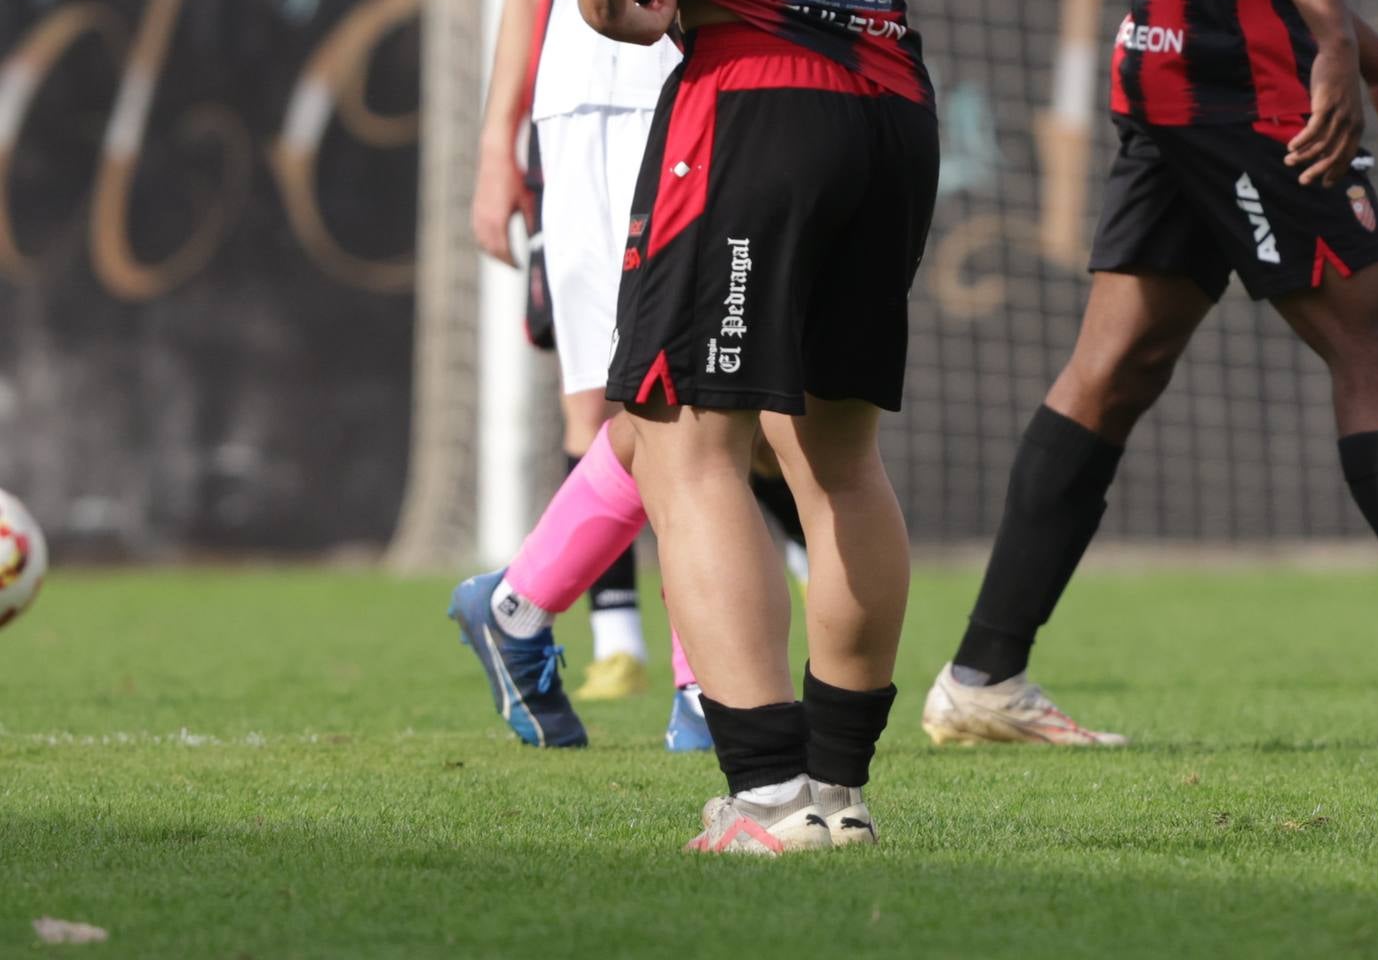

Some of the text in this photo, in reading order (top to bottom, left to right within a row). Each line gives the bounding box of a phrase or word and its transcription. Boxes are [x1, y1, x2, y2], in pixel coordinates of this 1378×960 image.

[1234, 170, 1282, 265] AVIA
[718, 237, 753, 374] El Pedragal
